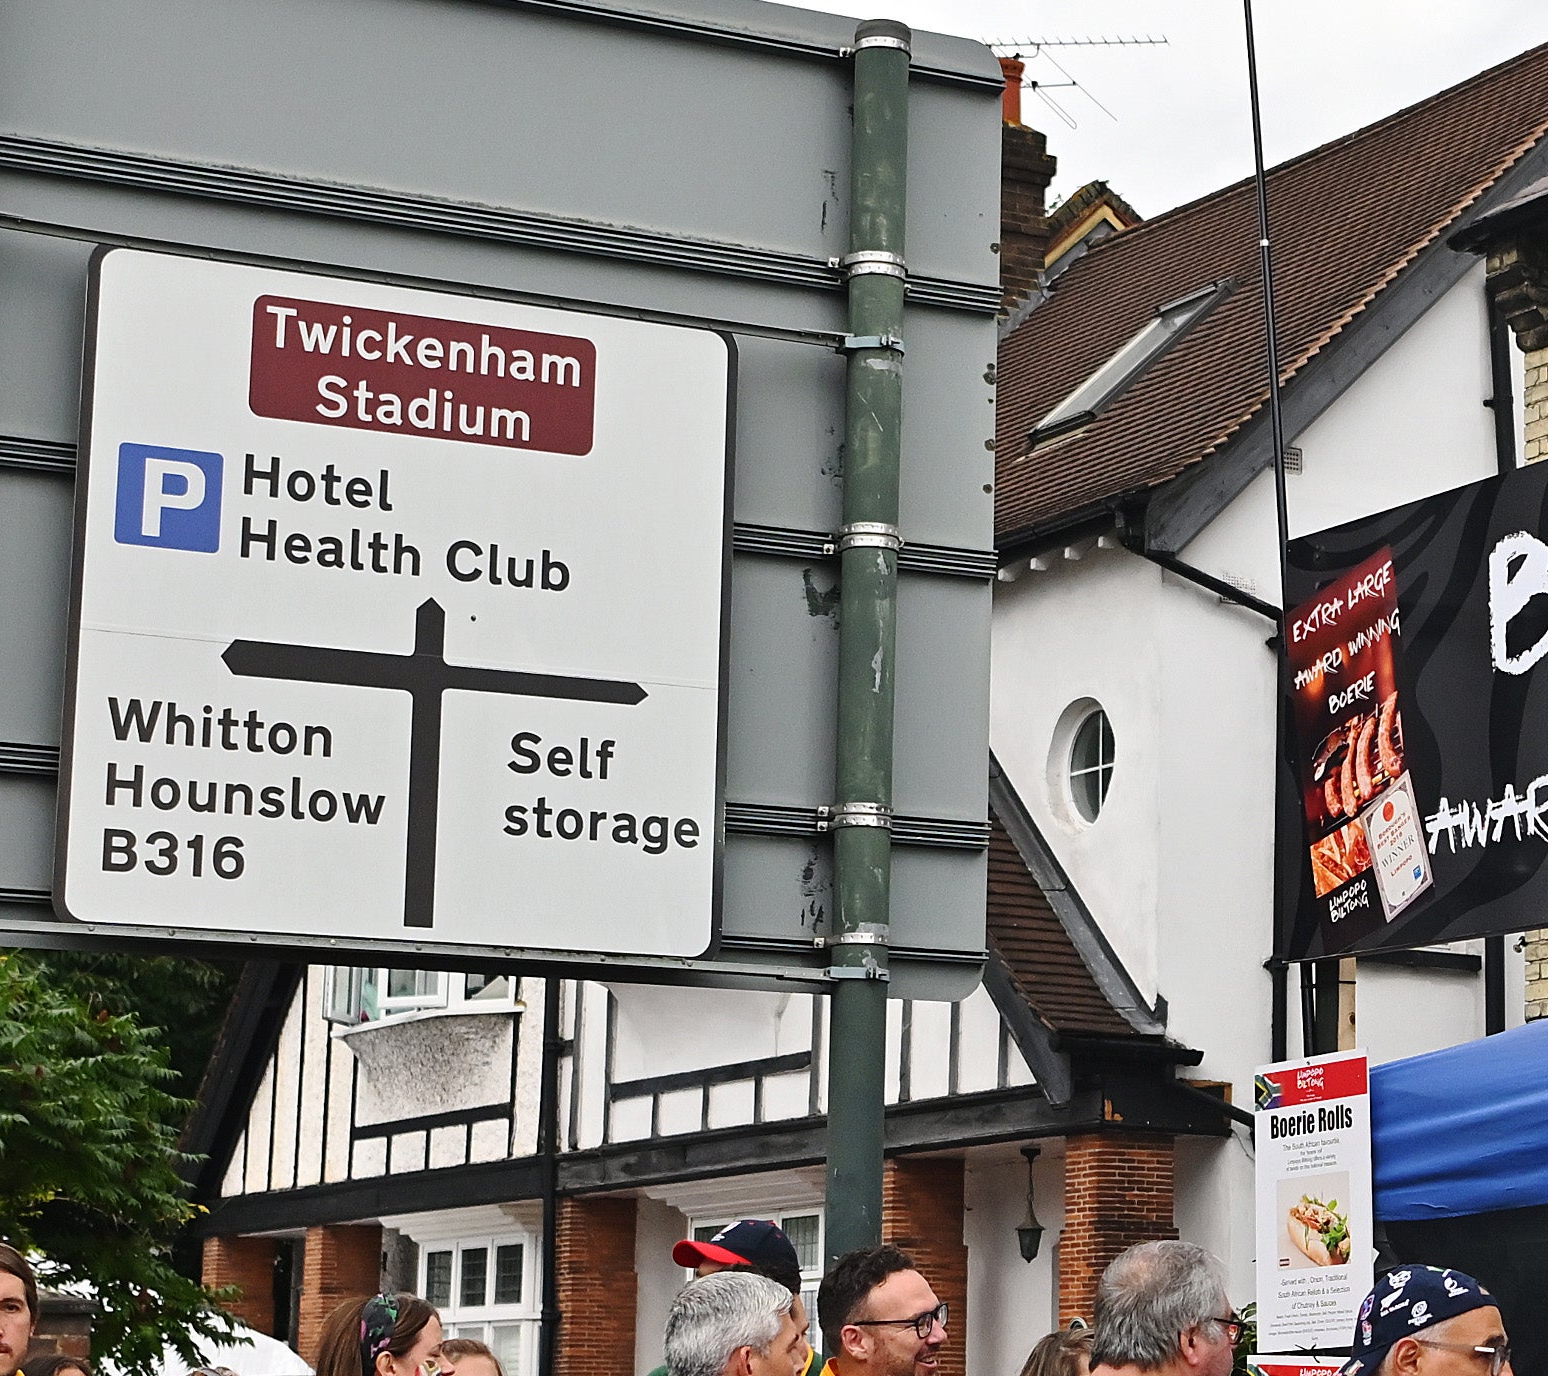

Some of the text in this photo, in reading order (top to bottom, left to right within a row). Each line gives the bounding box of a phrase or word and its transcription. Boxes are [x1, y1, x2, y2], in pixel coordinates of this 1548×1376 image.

[266, 306, 582, 388] Twickenham
[316, 375, 531, 443] Stadium
[141, 458, 208, 538] P
[242, 454, 394, 511] Hotel
[240, 516, 571, 593] Health Club
[1293, 560, 1392, 643] EXTRA LARGE
[1294, 607, 1401, 690] AWARD WINNING
[1328, 671, 1375, 714] BOERIE
[108, 697, 334, 760] Whitton
[508, 731, 615, 781] Self
[105, 764, 386, 828] Hounslow
[504, 797, 700, 855] storage
[101, 829, 246, 881] B316
[1329, 879, 1366, 911] LIMPOPO
[1331, 891, 1369, 923] BILTONG
[1271, 1104, 1353, 1139] Boerie Rolls
